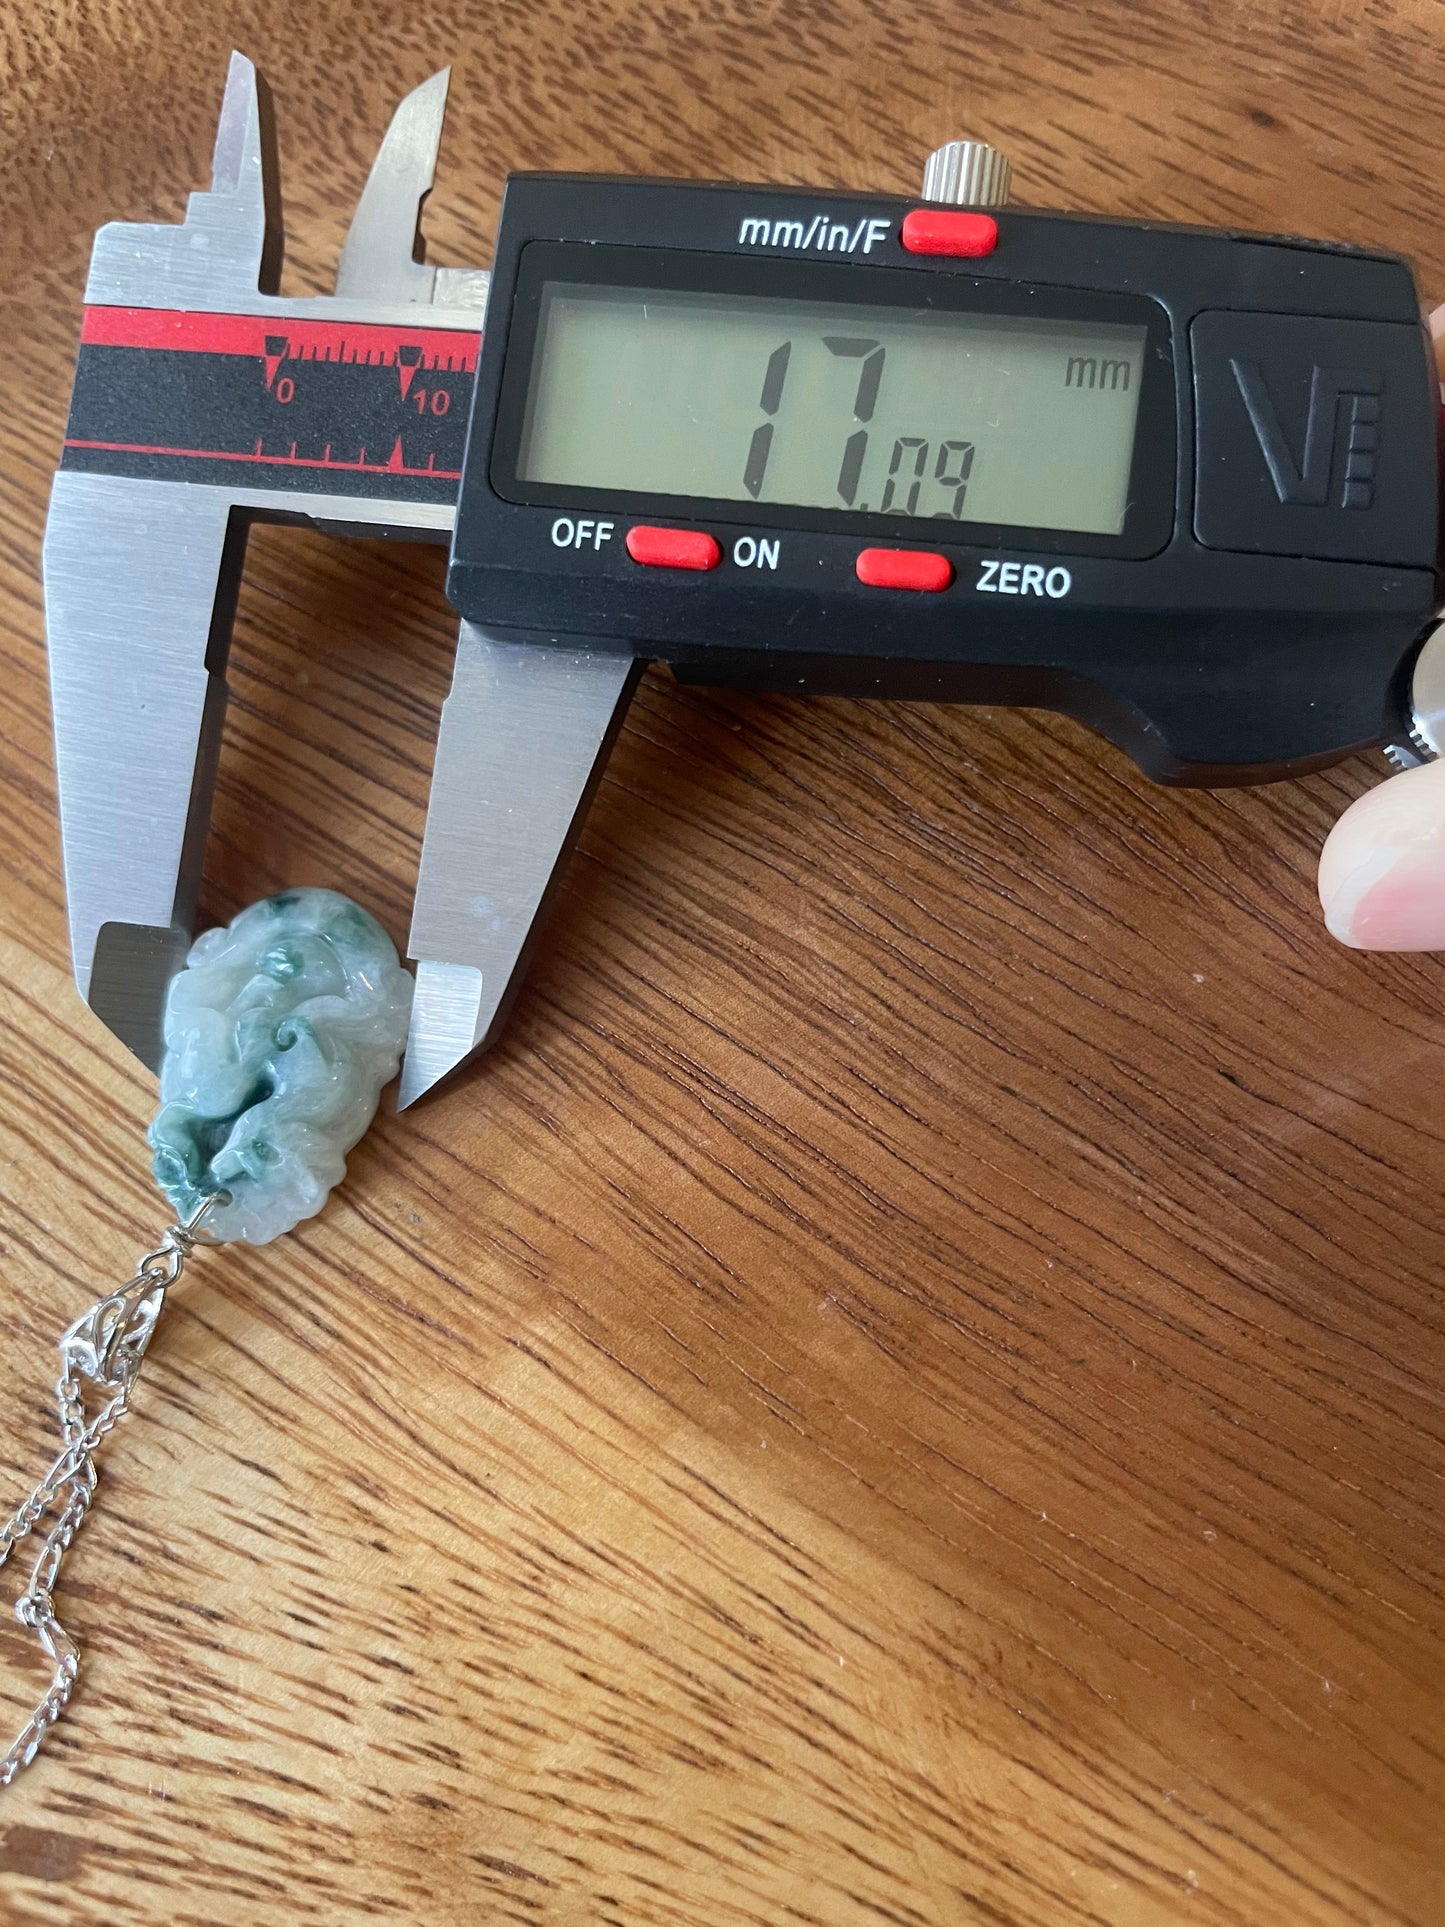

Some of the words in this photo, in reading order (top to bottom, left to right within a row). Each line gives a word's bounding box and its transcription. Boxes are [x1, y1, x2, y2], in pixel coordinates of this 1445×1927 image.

[738, 215, 891, 254] mm/in/F
[275, 377, 295, 404] 0
[1065, 356, 1131, 391] mm
[413, 388, 450, 416] 10
[743, 336, 975, 520] 17.09
[550, 517, 614, 551] OFF
[733, 536, 781, 570] ON
[976, 560, 1072, 598] ZERO
